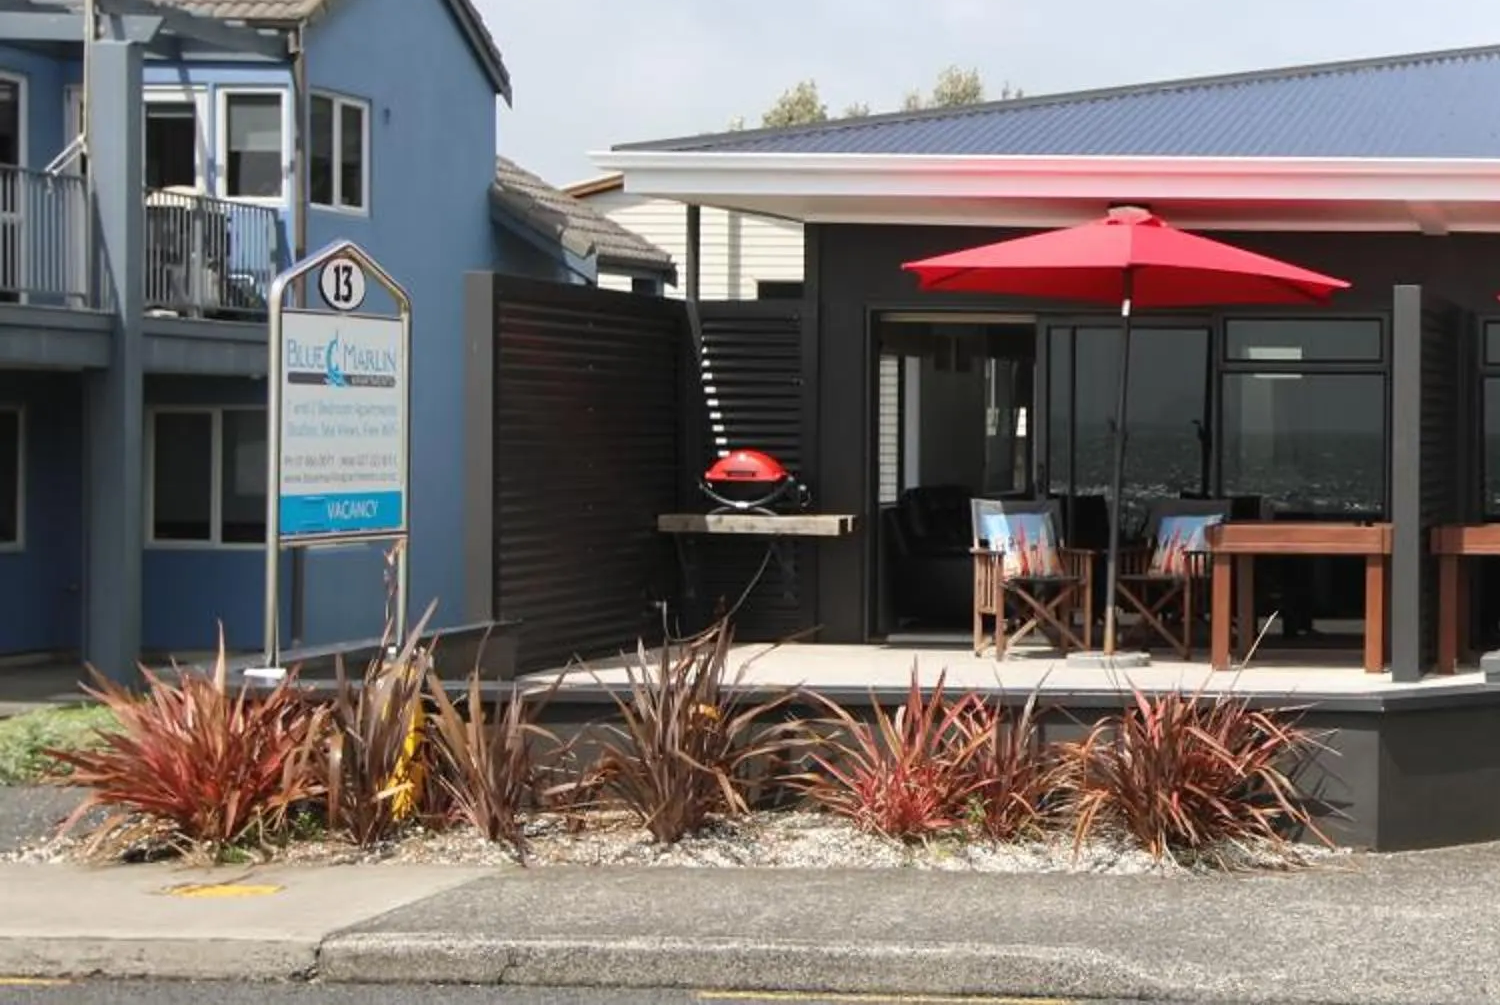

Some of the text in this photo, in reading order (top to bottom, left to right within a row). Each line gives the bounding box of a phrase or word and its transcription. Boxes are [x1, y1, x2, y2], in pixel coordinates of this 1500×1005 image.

[333, 264, 353, 303] 13
[286, 338, 398, 372] BLUE MARLIN
[327, 498, 379, 521] VACANCY
